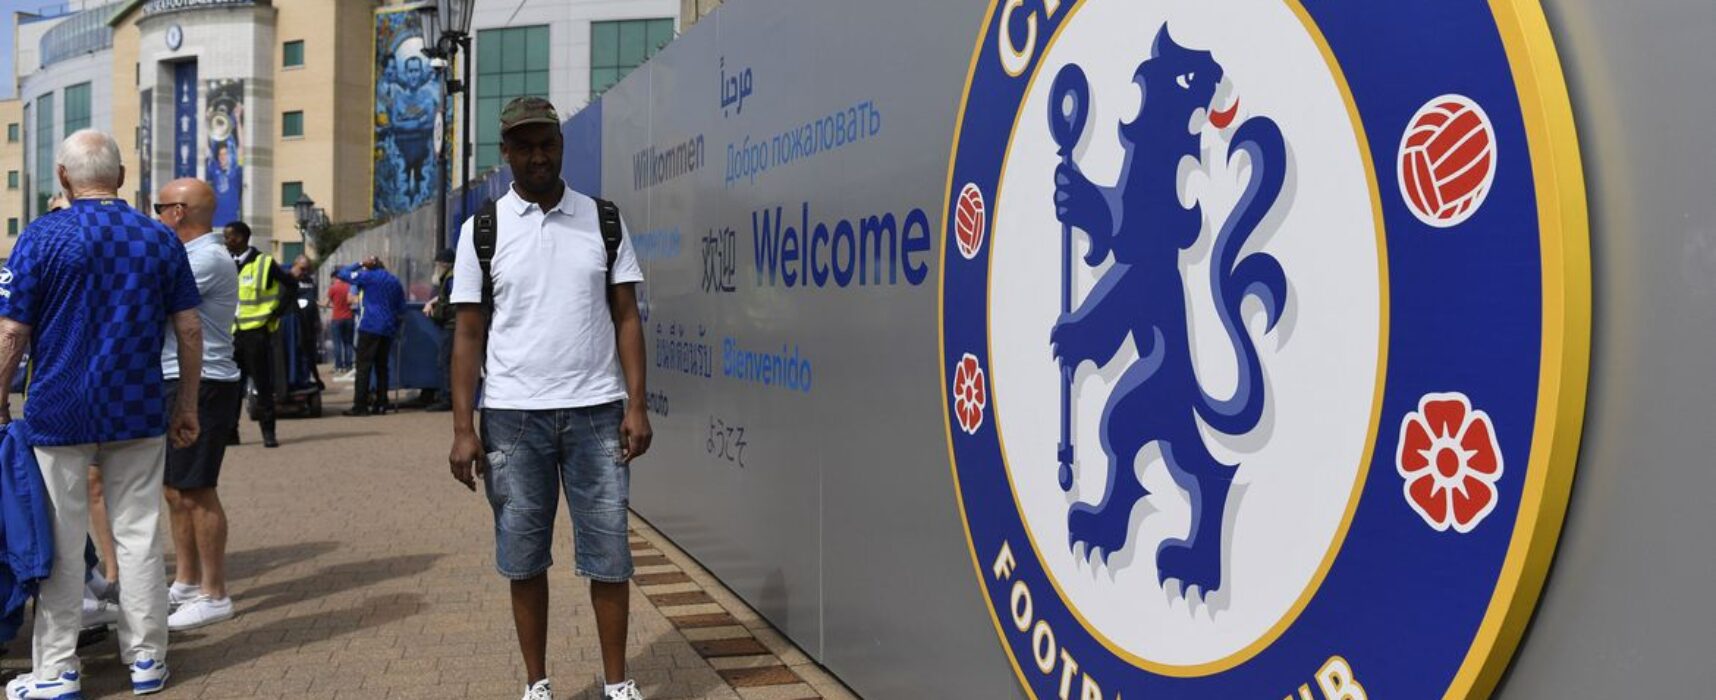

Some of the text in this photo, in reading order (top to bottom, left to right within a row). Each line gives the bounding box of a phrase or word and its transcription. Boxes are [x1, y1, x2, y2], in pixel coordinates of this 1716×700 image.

[998, 0, 1061, 77] C
[633, 133, 705, 191] Willkommen
[725, 100, 881, 189] Добро пожаловать
[702, 225, 736, 294] 欢迎
[752, 202, 931, 288] Welcome
[723, 336, 812, 394] Bienvenido
[706, 414, 747, 468] ようこそ
[993, 539, 1121, 700] FOOT
